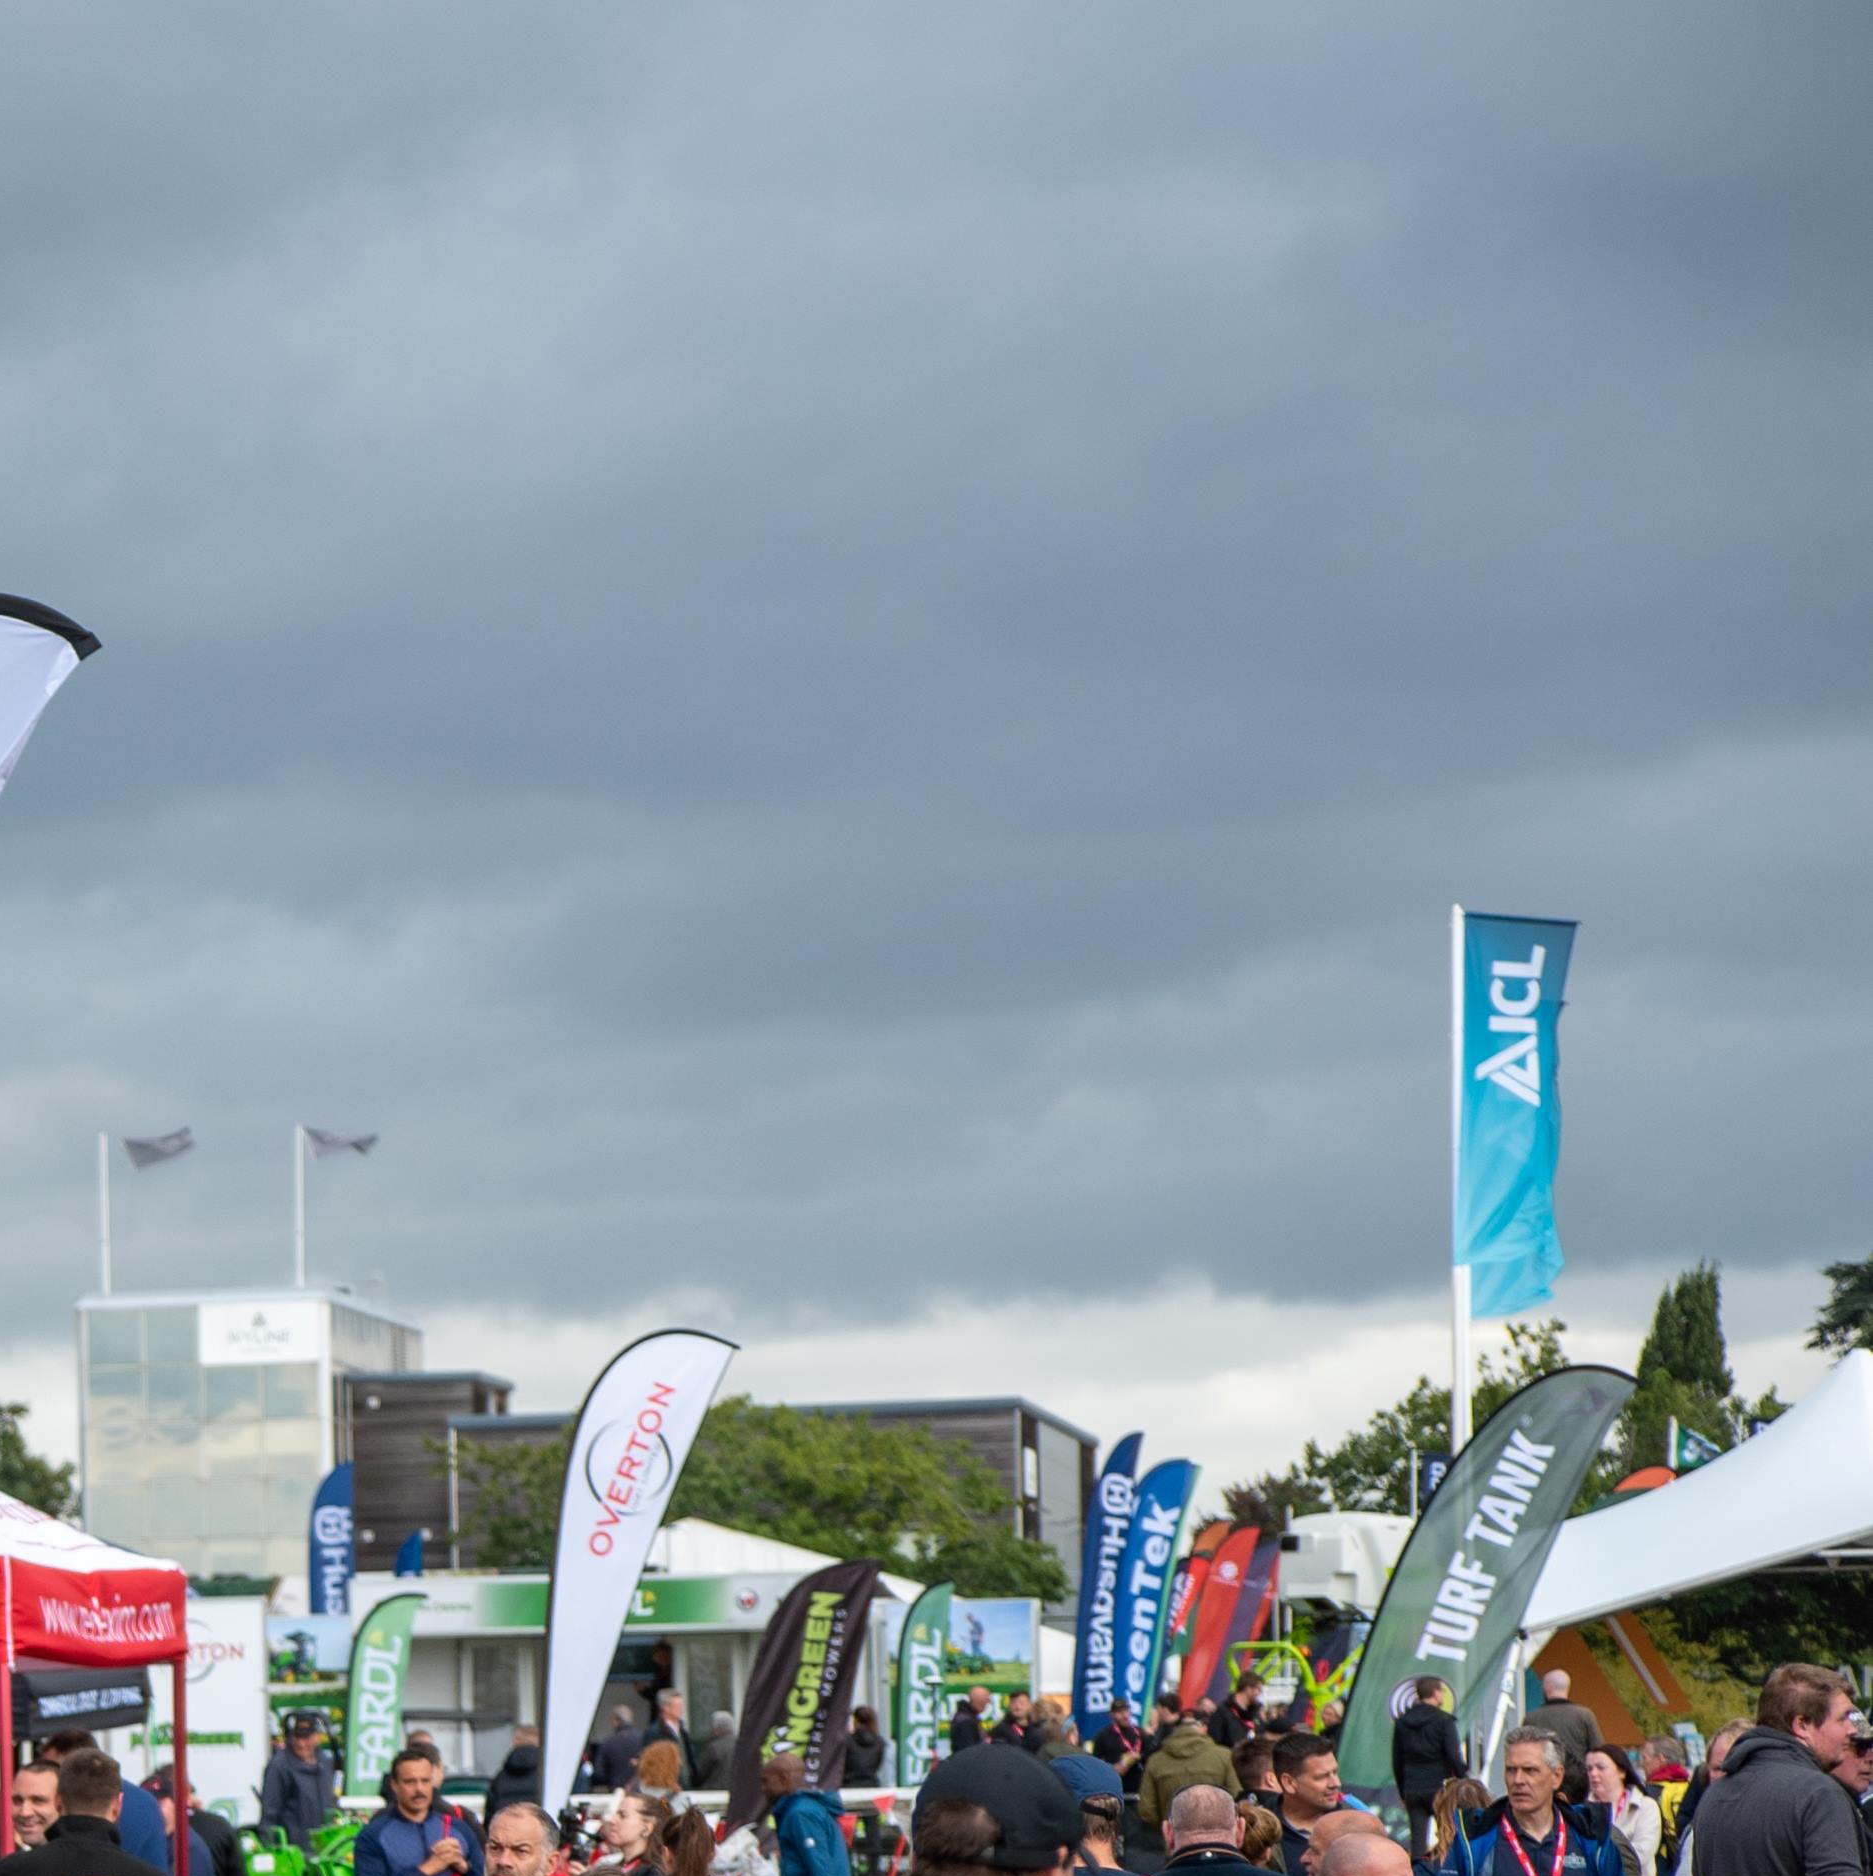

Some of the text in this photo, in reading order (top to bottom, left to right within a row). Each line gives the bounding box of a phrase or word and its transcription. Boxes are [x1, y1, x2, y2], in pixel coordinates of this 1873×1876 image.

[589, 1381, 677, 1557] OVERTON
[1415, 1427, 1556, 1663] TURF TANK
[1084, 1514, 1131, 1714] Husqvarna
